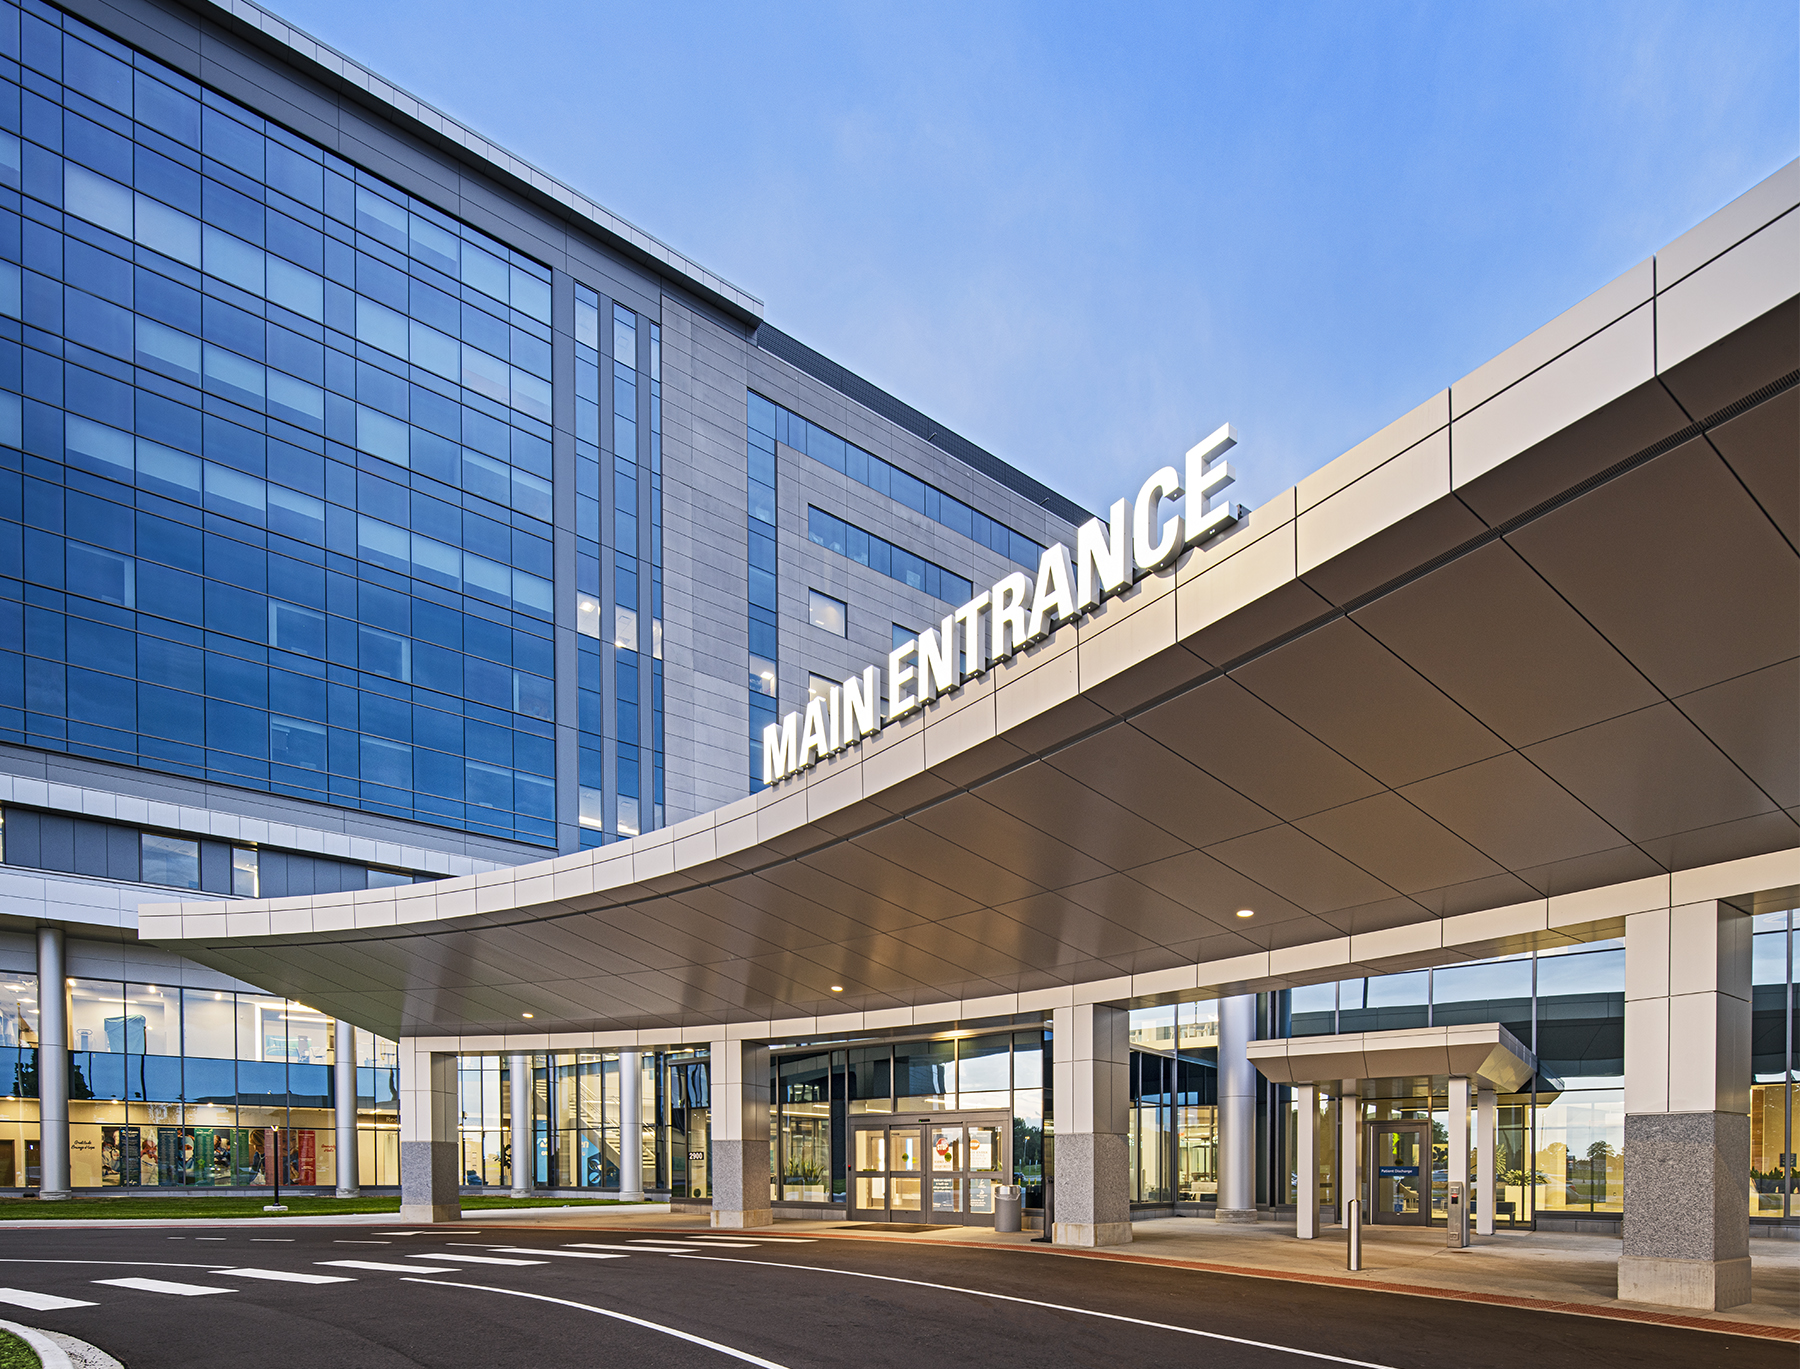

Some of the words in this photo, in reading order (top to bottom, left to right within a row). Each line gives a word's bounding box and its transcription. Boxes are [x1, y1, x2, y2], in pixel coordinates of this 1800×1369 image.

[763, 664, 881, 786] MAIN
[888, 422, 1238, 723] ENTRANCE
[689, 1152, 703, 1160] 2900
